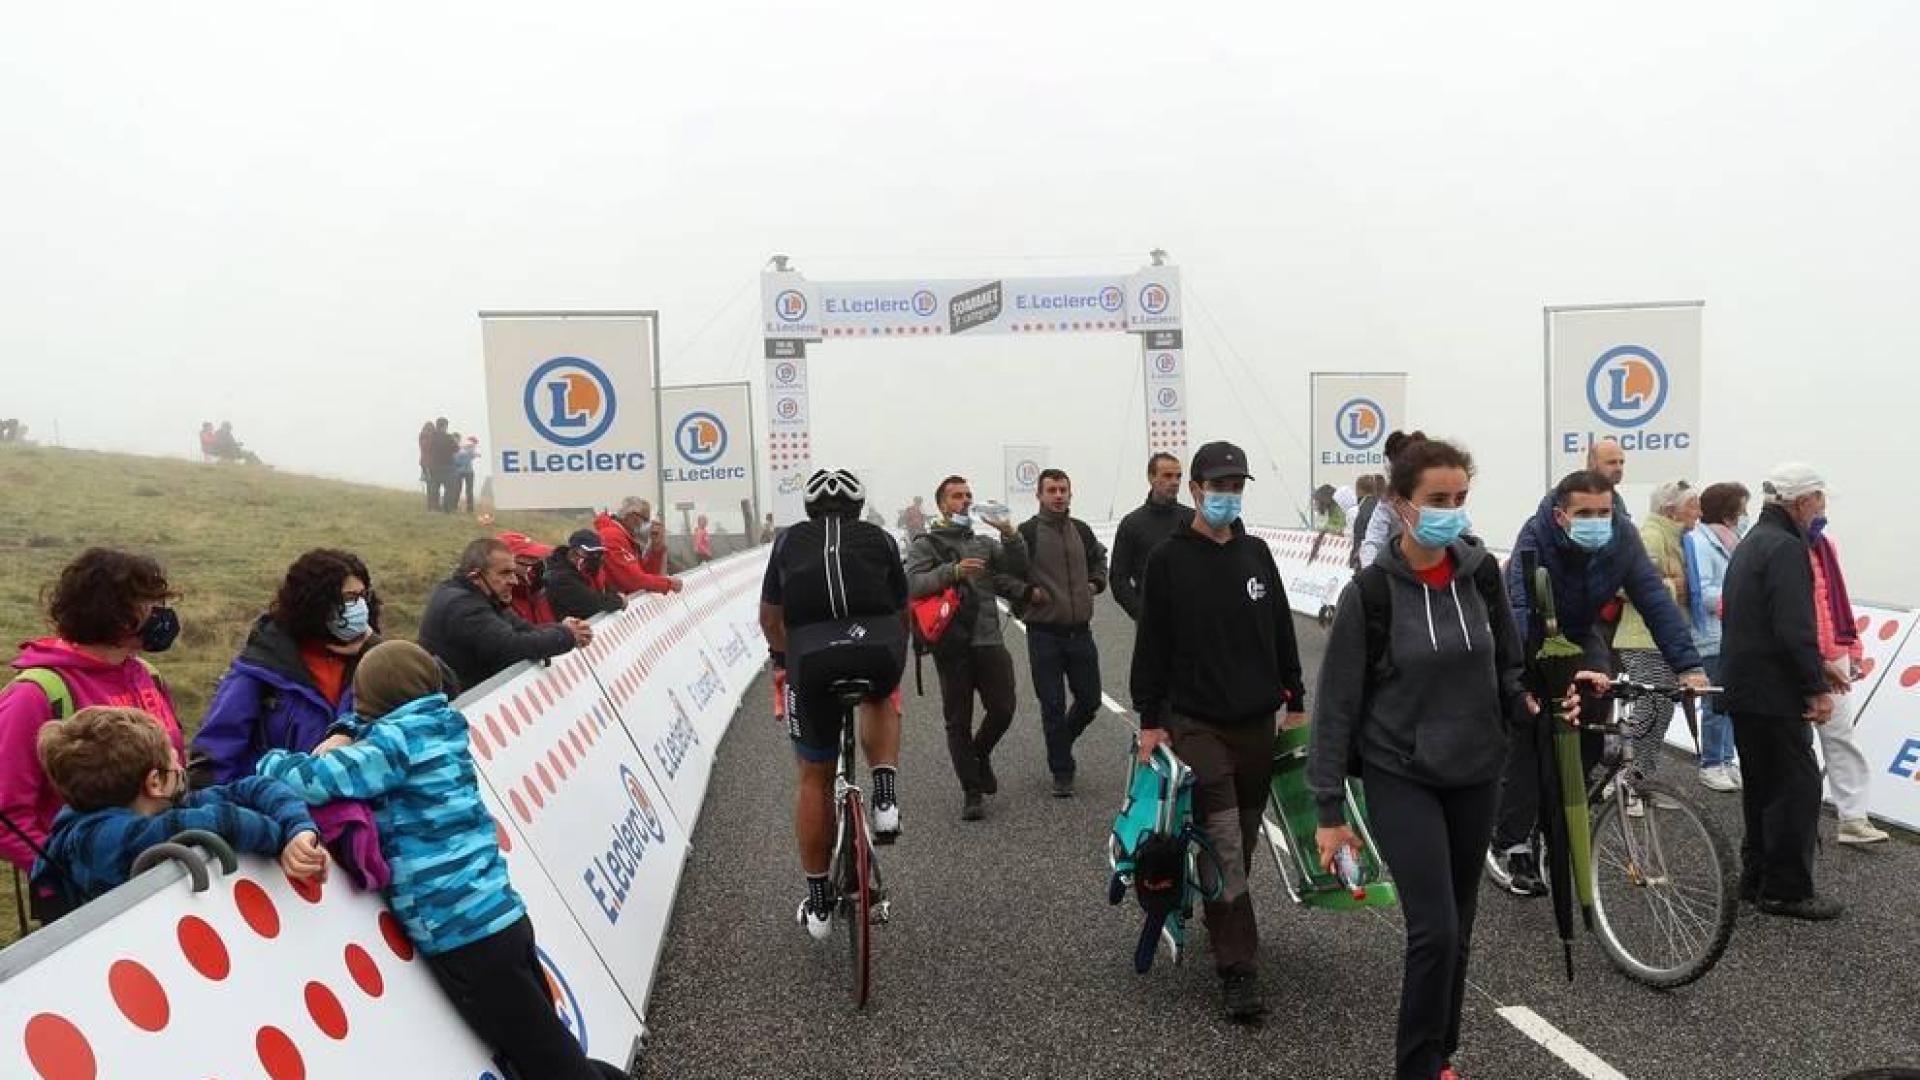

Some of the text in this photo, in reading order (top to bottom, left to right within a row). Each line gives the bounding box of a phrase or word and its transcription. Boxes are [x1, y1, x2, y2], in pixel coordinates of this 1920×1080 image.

[825, 298, 909, 313] E.Leclerc
[1016, 292, 1098, 309] E.Leclerc
[1563, 430, 1690, 453] E.Lclerc
[502, 450, 645, 473] E.Leclerc
[1322, 451, 1387, 464] E.Lecle
[664, 466, 745, 482] E.Leclerc
[584, 807, 649, 926] E.Leclerc
